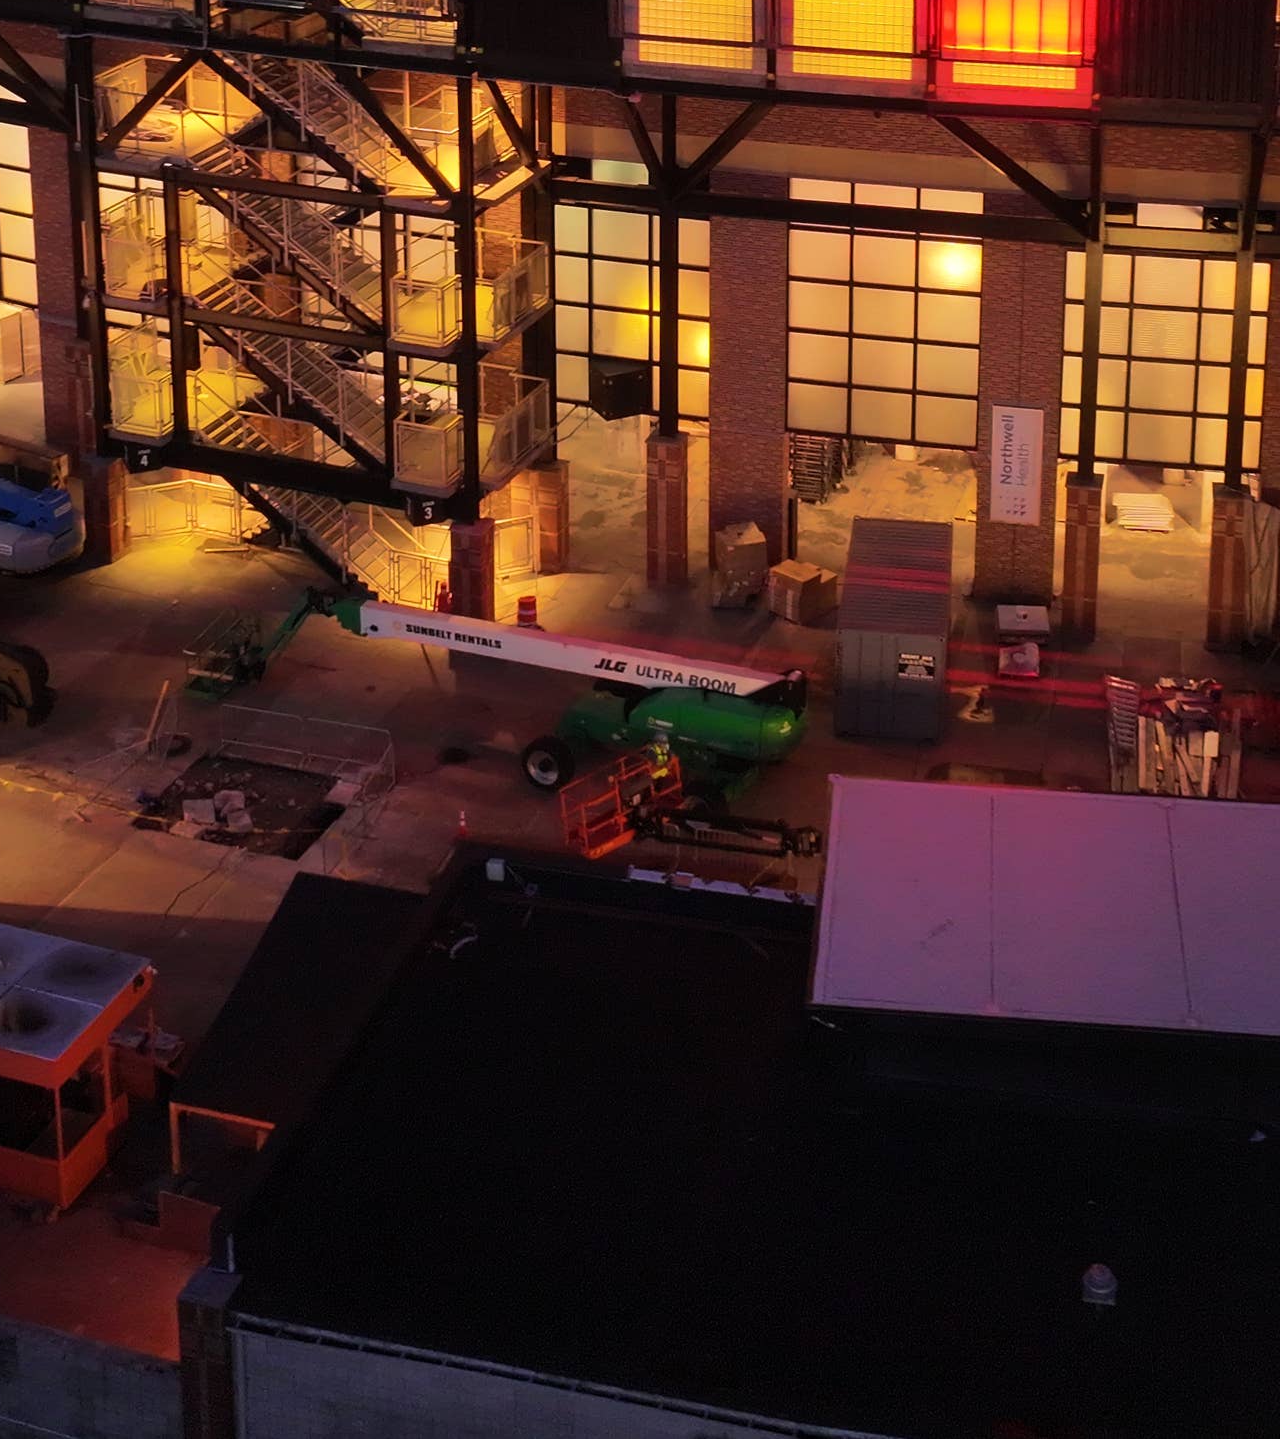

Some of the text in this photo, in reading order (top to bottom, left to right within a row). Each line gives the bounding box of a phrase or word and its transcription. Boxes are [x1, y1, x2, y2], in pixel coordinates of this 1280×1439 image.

[1000, 414, 1015, 485] Northwell
[423, 506, 433, 520] 3
[406, 624, 502, 649] SUNBELT RENTALS
[594, 658, 736, 695] JLG ULTRA BOOM
